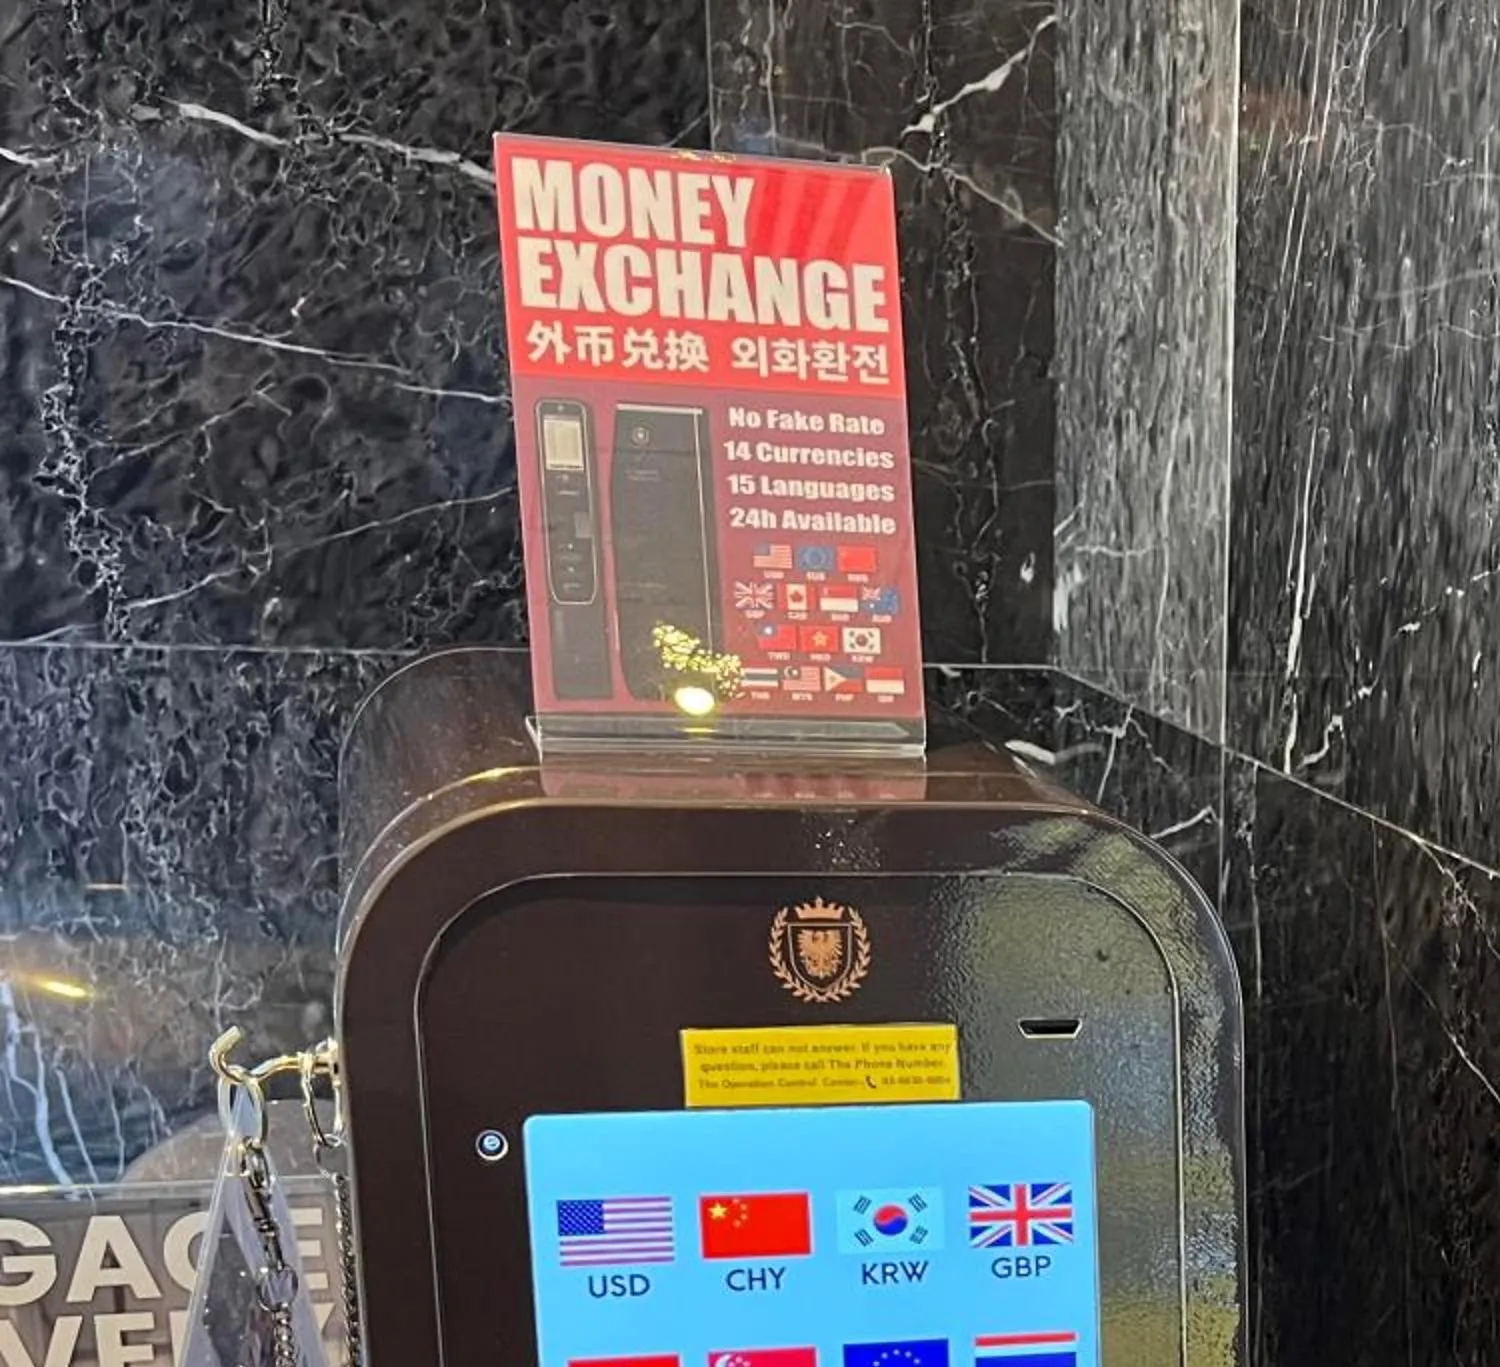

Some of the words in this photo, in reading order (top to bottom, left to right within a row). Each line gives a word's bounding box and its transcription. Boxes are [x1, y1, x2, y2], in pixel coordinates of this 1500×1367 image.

[511, 157, 754, 247] MONEY
[517, 237, 889, 332] EXCHANGE
[526, 320, 709, 372] 外币兑换
[730, 336, 890, 384] 외화환전
[728, 408, 762, 429] No
[767, 409, 824, 432] Fake
[830, 413, 884, 435] Rate
[724, 440, 752, 461] 14
[757, 444, 894, 469] Currencies
[728, 474, 755, 495] 15
[761, 475, 894, 503] Languages
[729, 508, 776, 529] 24h
[782, 509, 896, 535] Available
[588, 1273, 650, 1298] USD
[725, 1267, 786, 1292] CHY
[861, 1261, 930, 1285] KRW
[991, 1255, 1051, 1279] GBP
